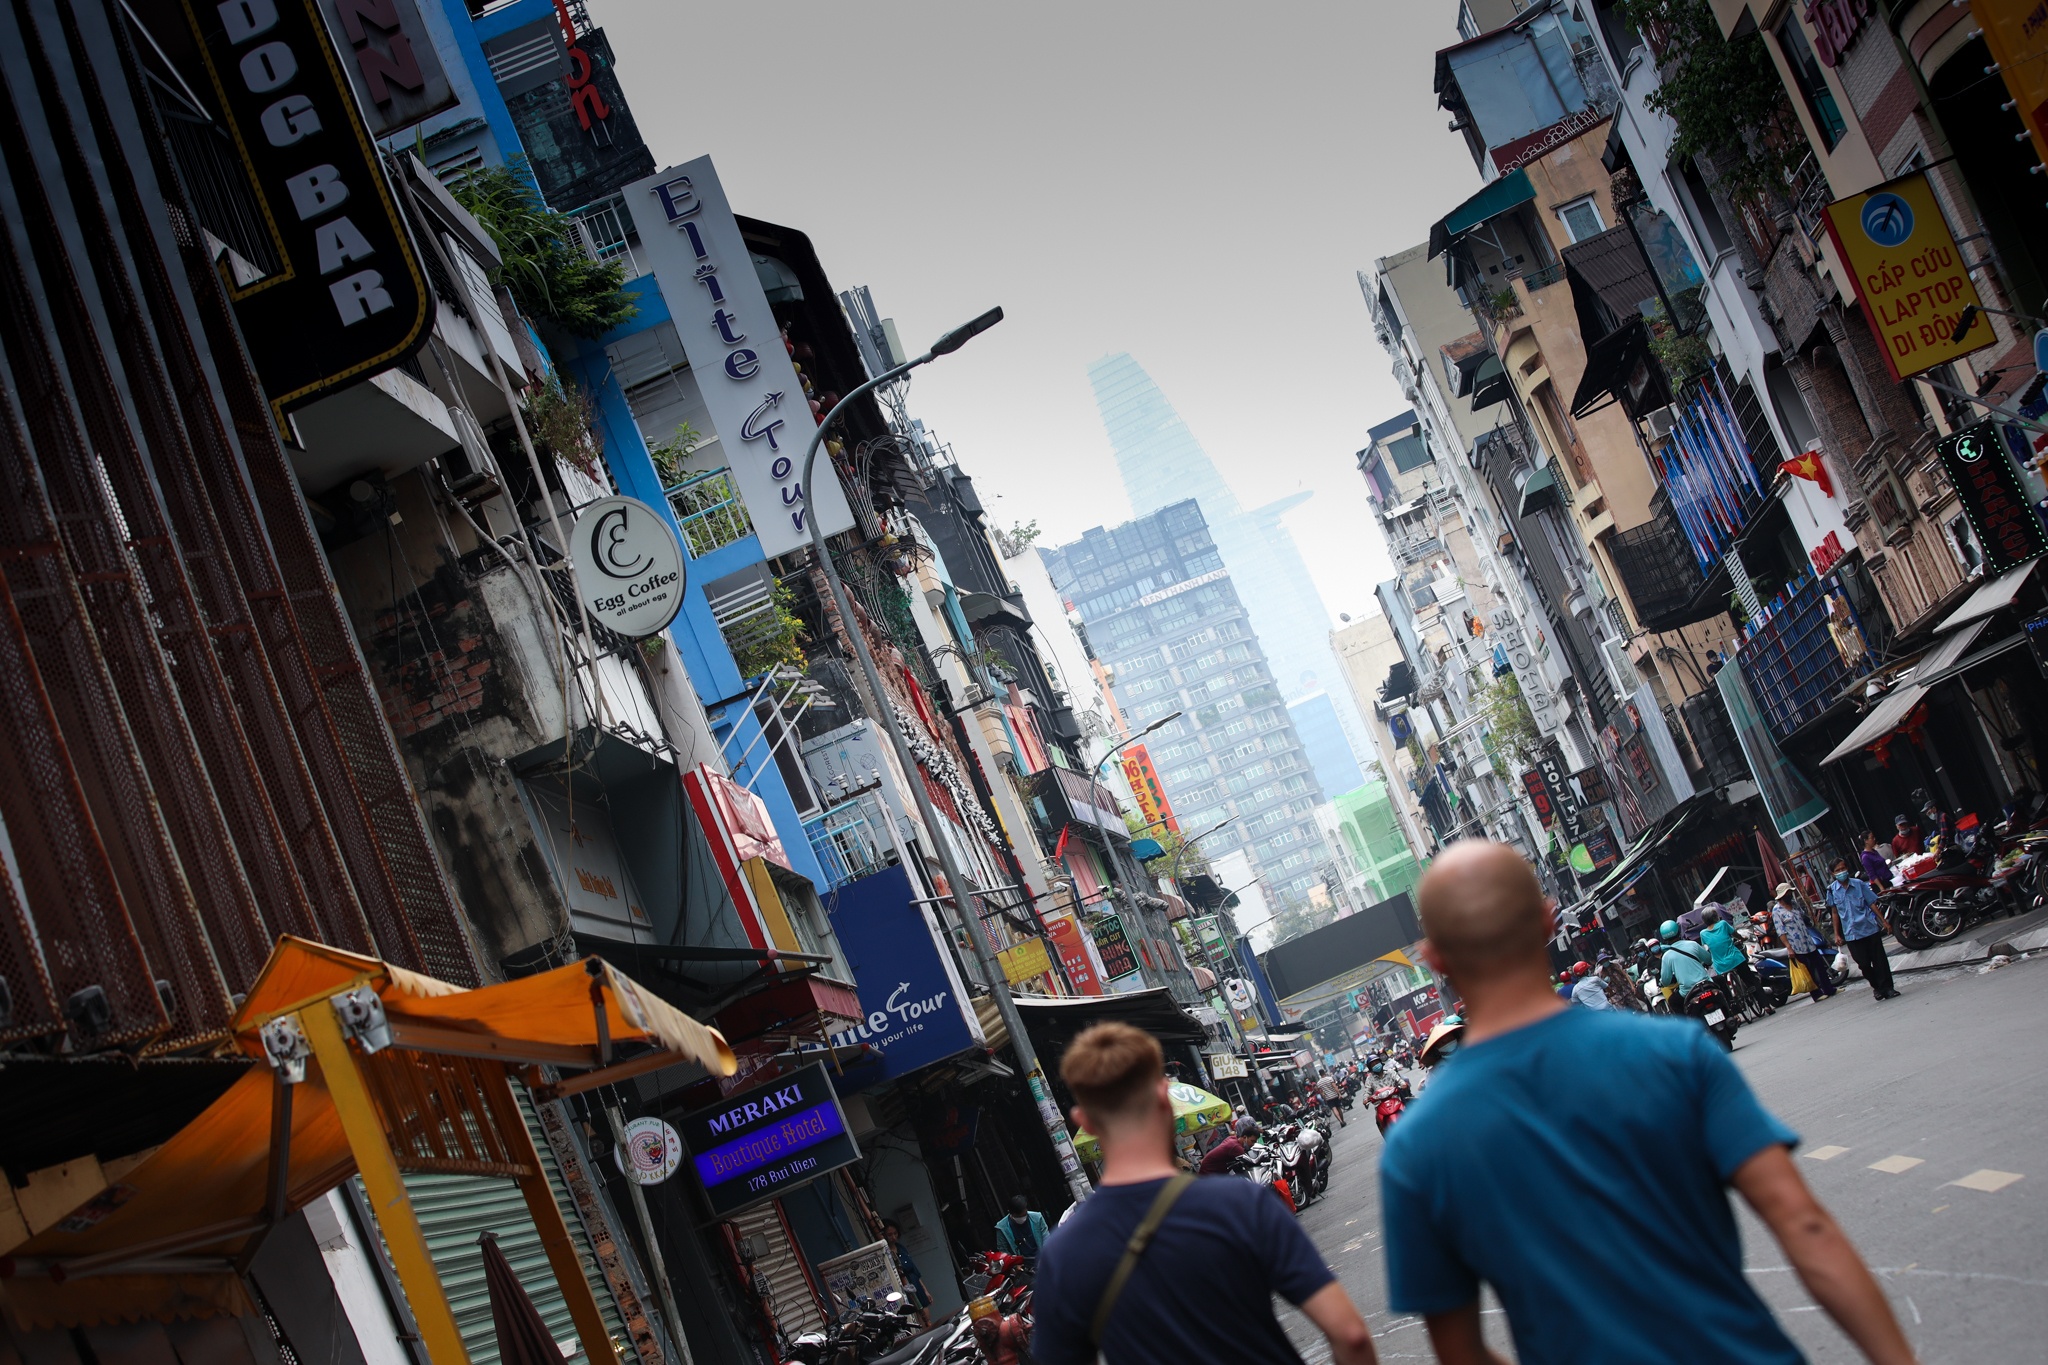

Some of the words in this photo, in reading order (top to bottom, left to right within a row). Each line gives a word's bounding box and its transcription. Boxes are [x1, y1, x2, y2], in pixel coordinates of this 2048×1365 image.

[217, 0, 324, 148] DOG
[285, 163, 394, 328] BAR
[1866, 259, 1905, 295] CẤP
[1910, 246, 1953, 278] CỨU
[1878, 275, 1964, 327] LAPTOP
[649, 175, 761, 380] Elite
[740, 396, 807, 533] Tour
[1892, 331, 1918, 357] DI
[593, 593, 626, 614] Egg
[628, 571, 679, 598] Coffee
[616, 607, 628, 617] all
[628, 598, 651, 612] about
[652, 591, 668, 603] egg
[1142, 592, 1163, 606] BEN
[1163, 578, 1200, 599] THANH
[1200, 568, 1228, 585] LAND
[1491, 609, 1514, 630] 99
[1500, 628, 1558, 733] HOTEL
[1110, 932, 1121, 942] CUT
[886, 989, 947, 1022] Tour
[881, 1031, 904, 1047] your
[906, 1023, 924, 1035] life
[1220, 1065, 1240, 1077] 148
[707, 1083, 804, 1136] MERAKI
[709, 1134, 781, 1175] Boutique
[781, 1110, 827, 1146] Hotel
[747, 1175, 768, 1192] 178
